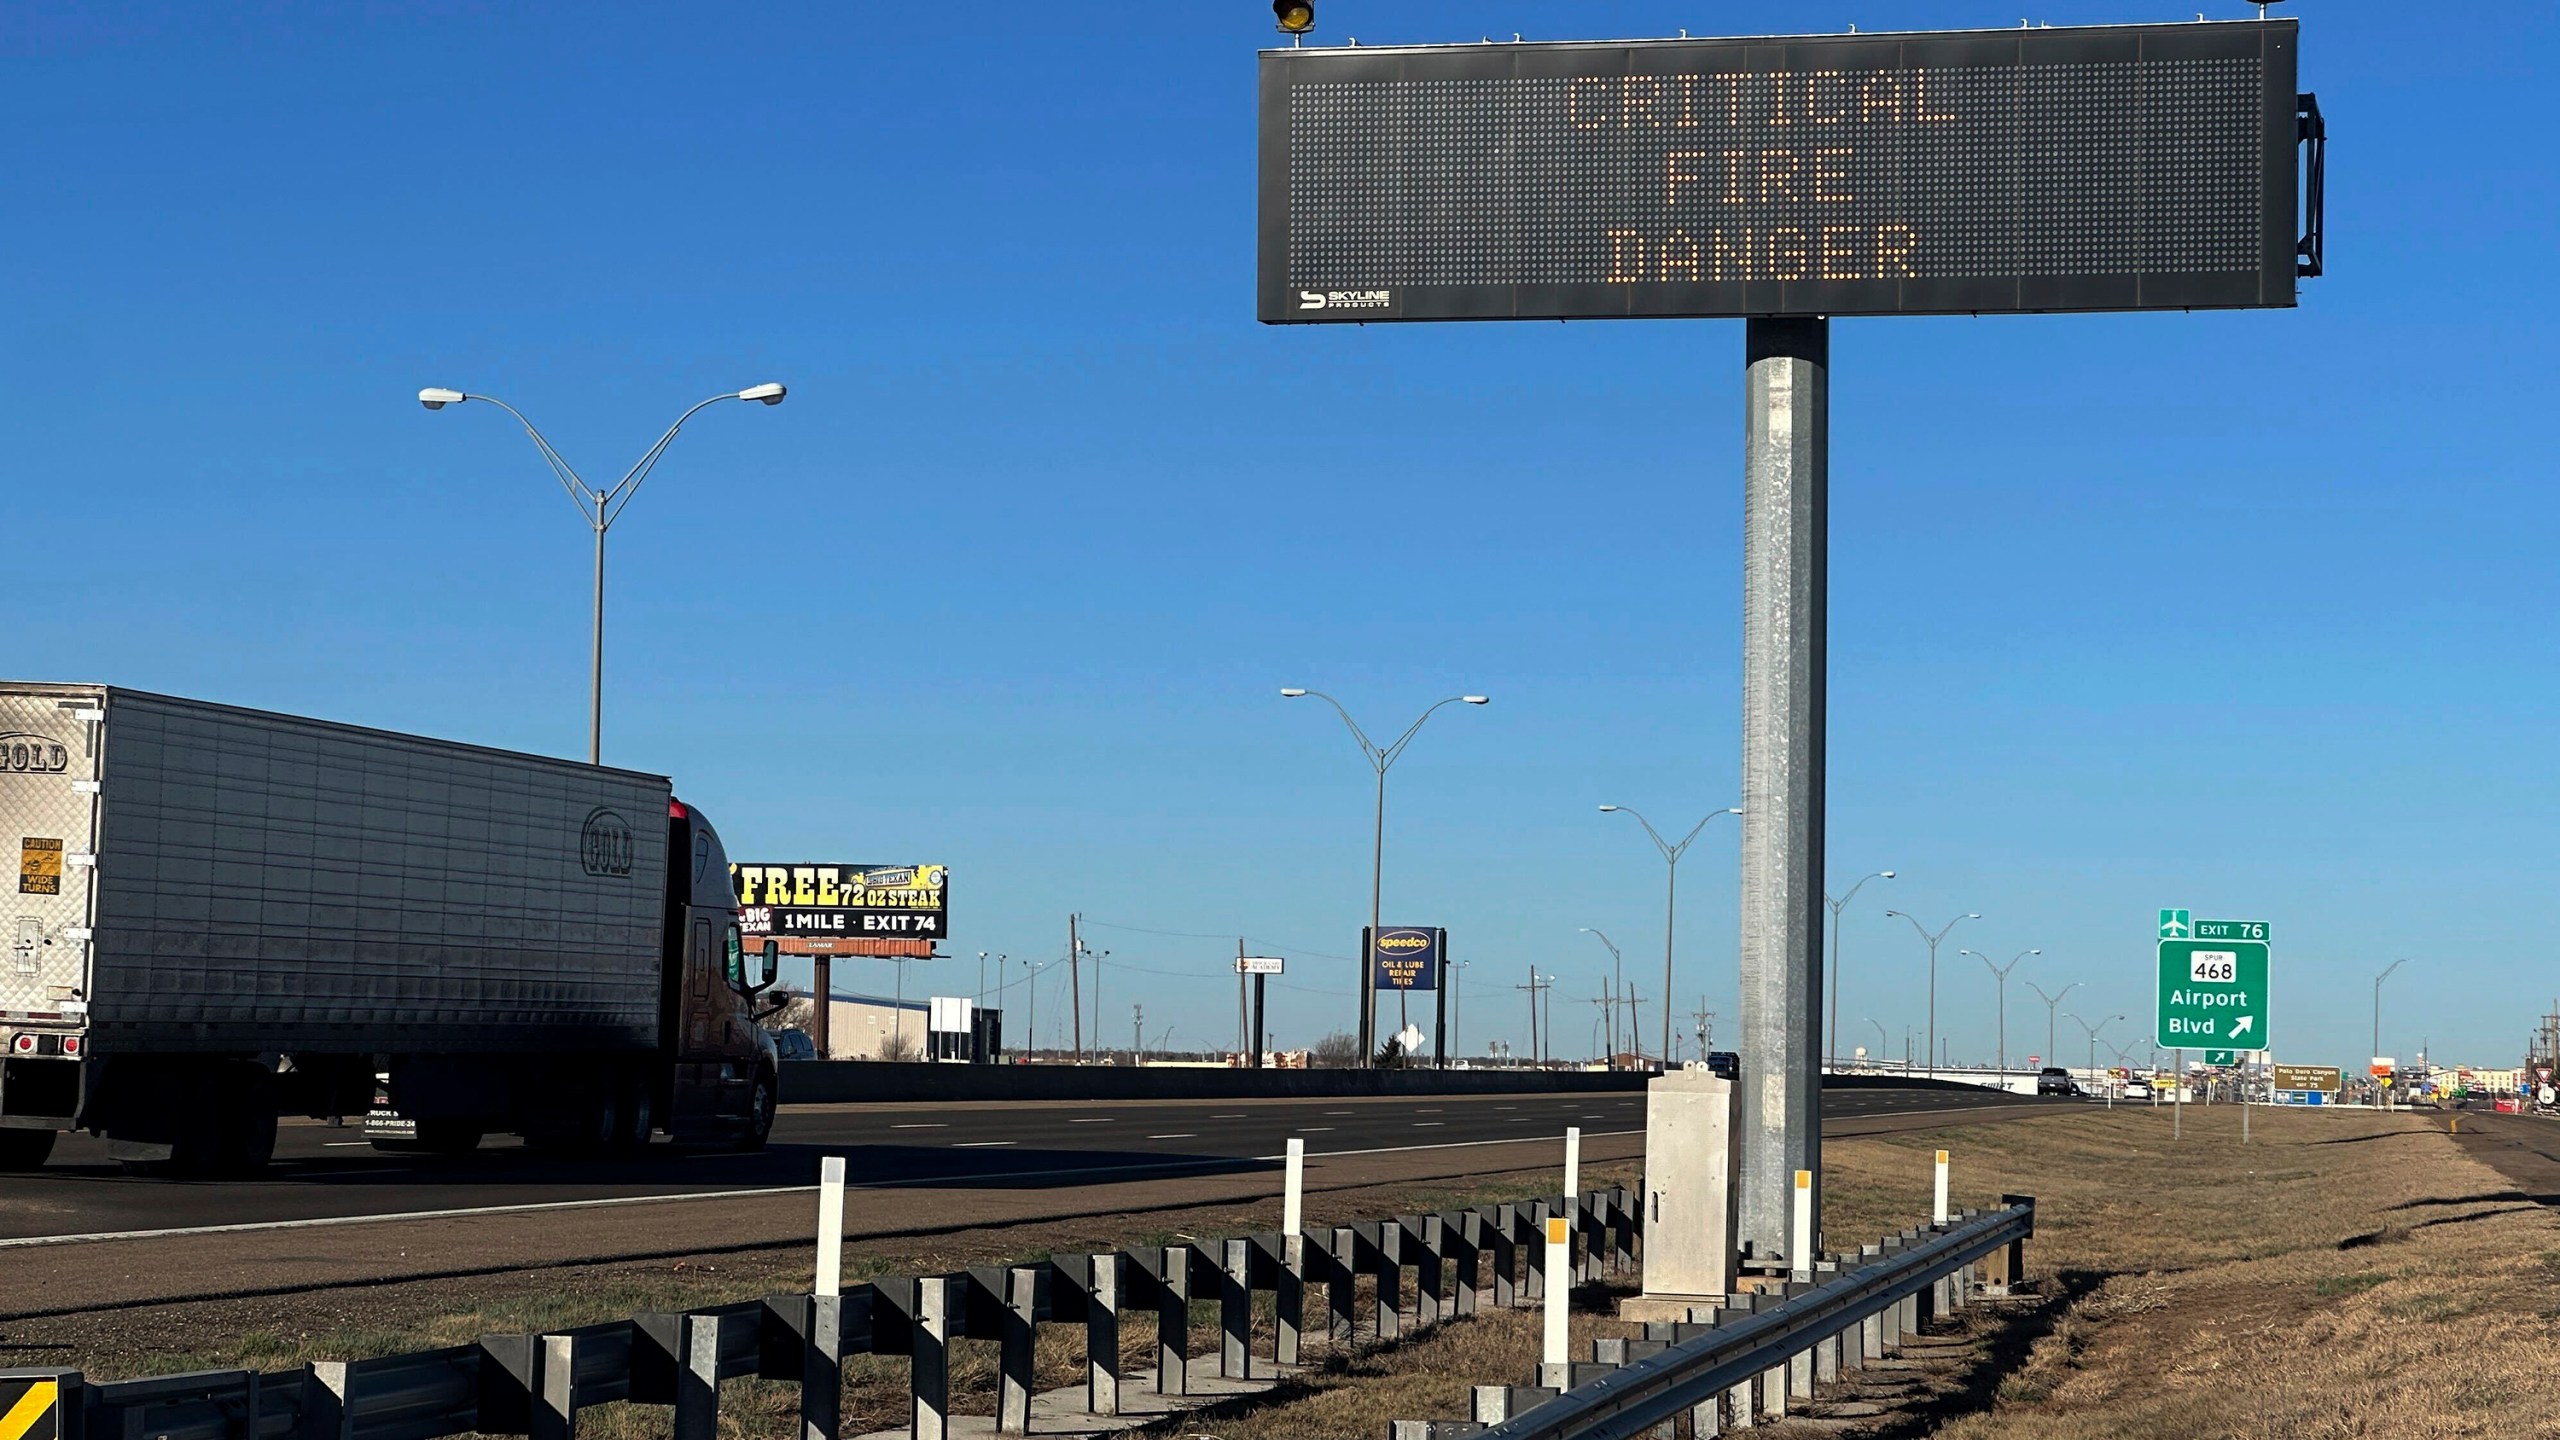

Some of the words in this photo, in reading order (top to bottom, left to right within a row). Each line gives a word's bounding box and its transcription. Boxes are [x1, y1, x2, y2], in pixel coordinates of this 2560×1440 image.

[1569, 68, 1956, 129] CRITICAL
[1668, 147, 1854, 205] FIRE
[1607, 224, 1917, 283] DANGER
[1328, 290, 1390, 300] SKYLINE
[24, 838, 61, 850] CAUTION
[586, 826, 633, 875] GOLD
[22, 883, 56, 893] TURNS
[27, 875, 54, 885] WIDE
[741, 867, 839, 906] FREE
[840, 884, 865, 906] 72
[867, 889, 887, 907] OZ
[888, 889, 941, 907] STEAK
[745, 907, 771, 922] BIG
[797, 914, 845, 929] MILE
[863, 915, 910, 931] EXIT
[914, 915, 936, 931] 74
[2200, 925, 2229, 936] EXIT
[2240, 923, 2264, 938] 76
[1380, 937, 1428, 949] speedco
[1382, 961, 1396, 969] OIL
[1405, 961, 1425, 969] LUBE
[2194, 963, 2232, 980] 468
[2170, 988, 2247, 1010] Airport
[2169, 1017, 2215, 1034] Blvd
